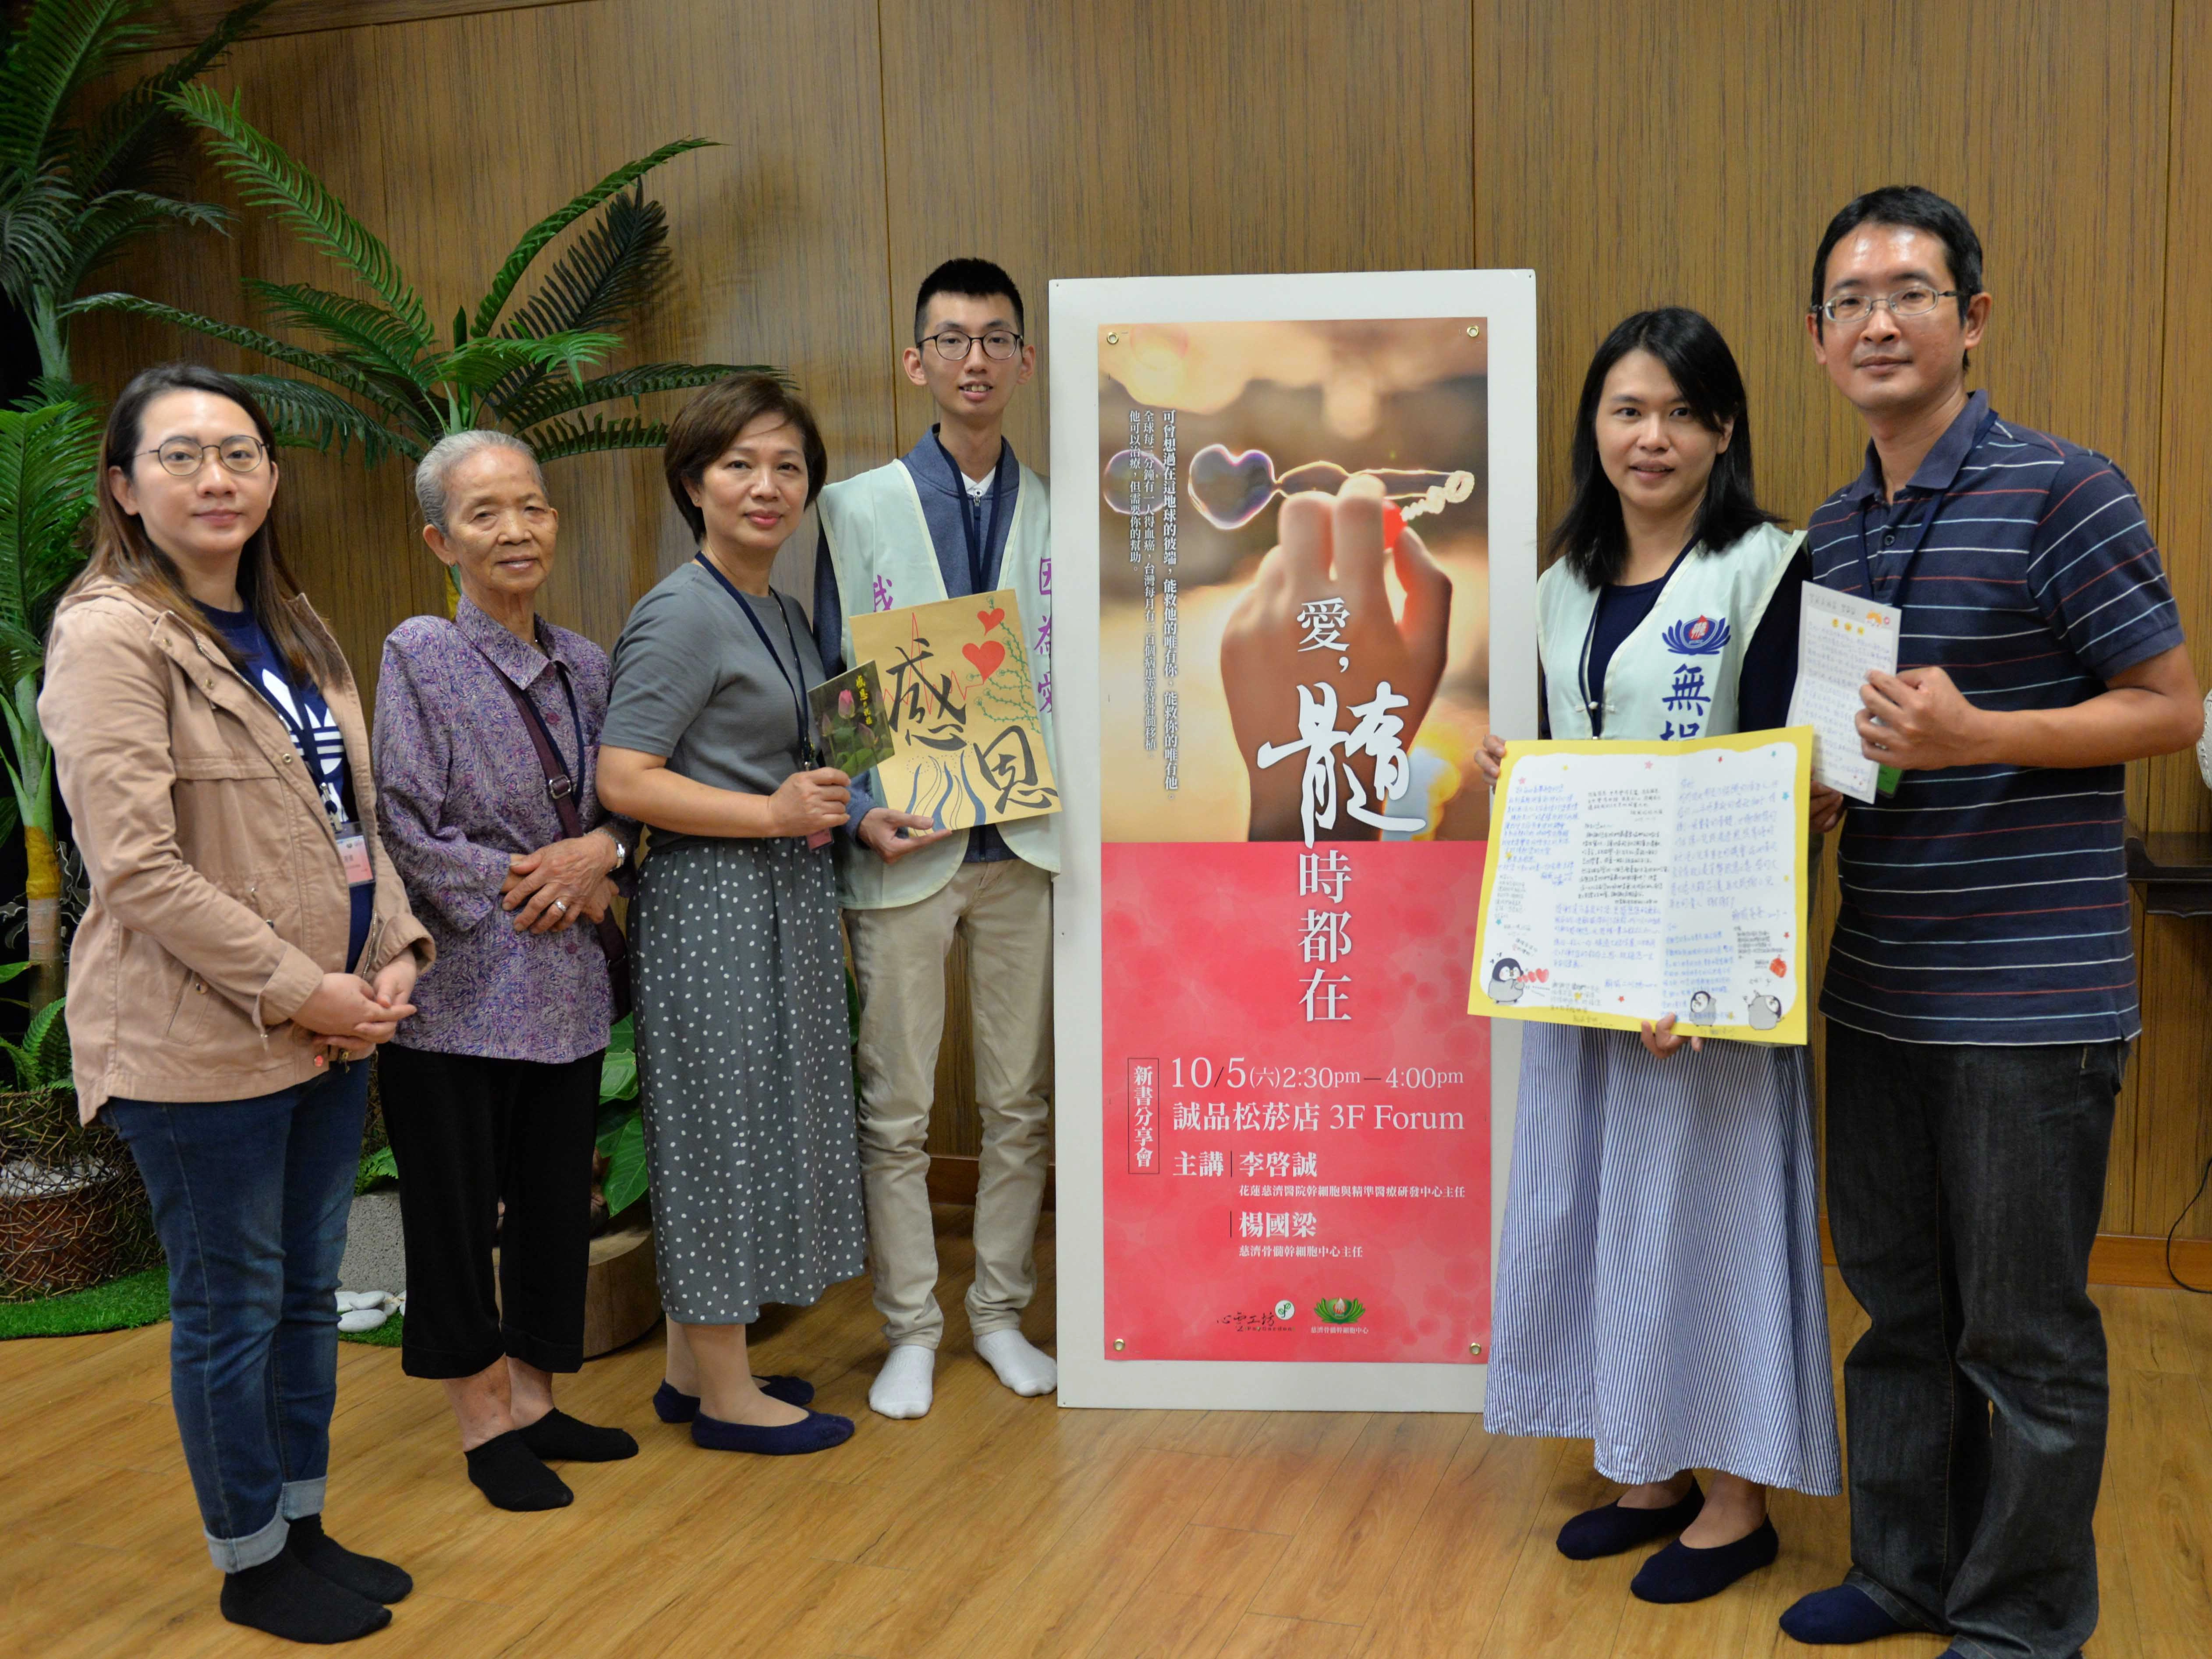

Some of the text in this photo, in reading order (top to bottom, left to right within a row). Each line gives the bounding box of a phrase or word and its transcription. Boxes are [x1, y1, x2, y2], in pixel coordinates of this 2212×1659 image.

[1134, 1065, 1154, 1168] 新書分享會
[1173, 1101, 1466, 1132] 誠品松菸店 3F Forum
[1173, 1151, 1223, 1177] 主講
[1238, 1211, 1317, 1238] 楊國梁
[1239, 1245, 1363, 1258] 慈濟骨髓幹細胞中心主任
